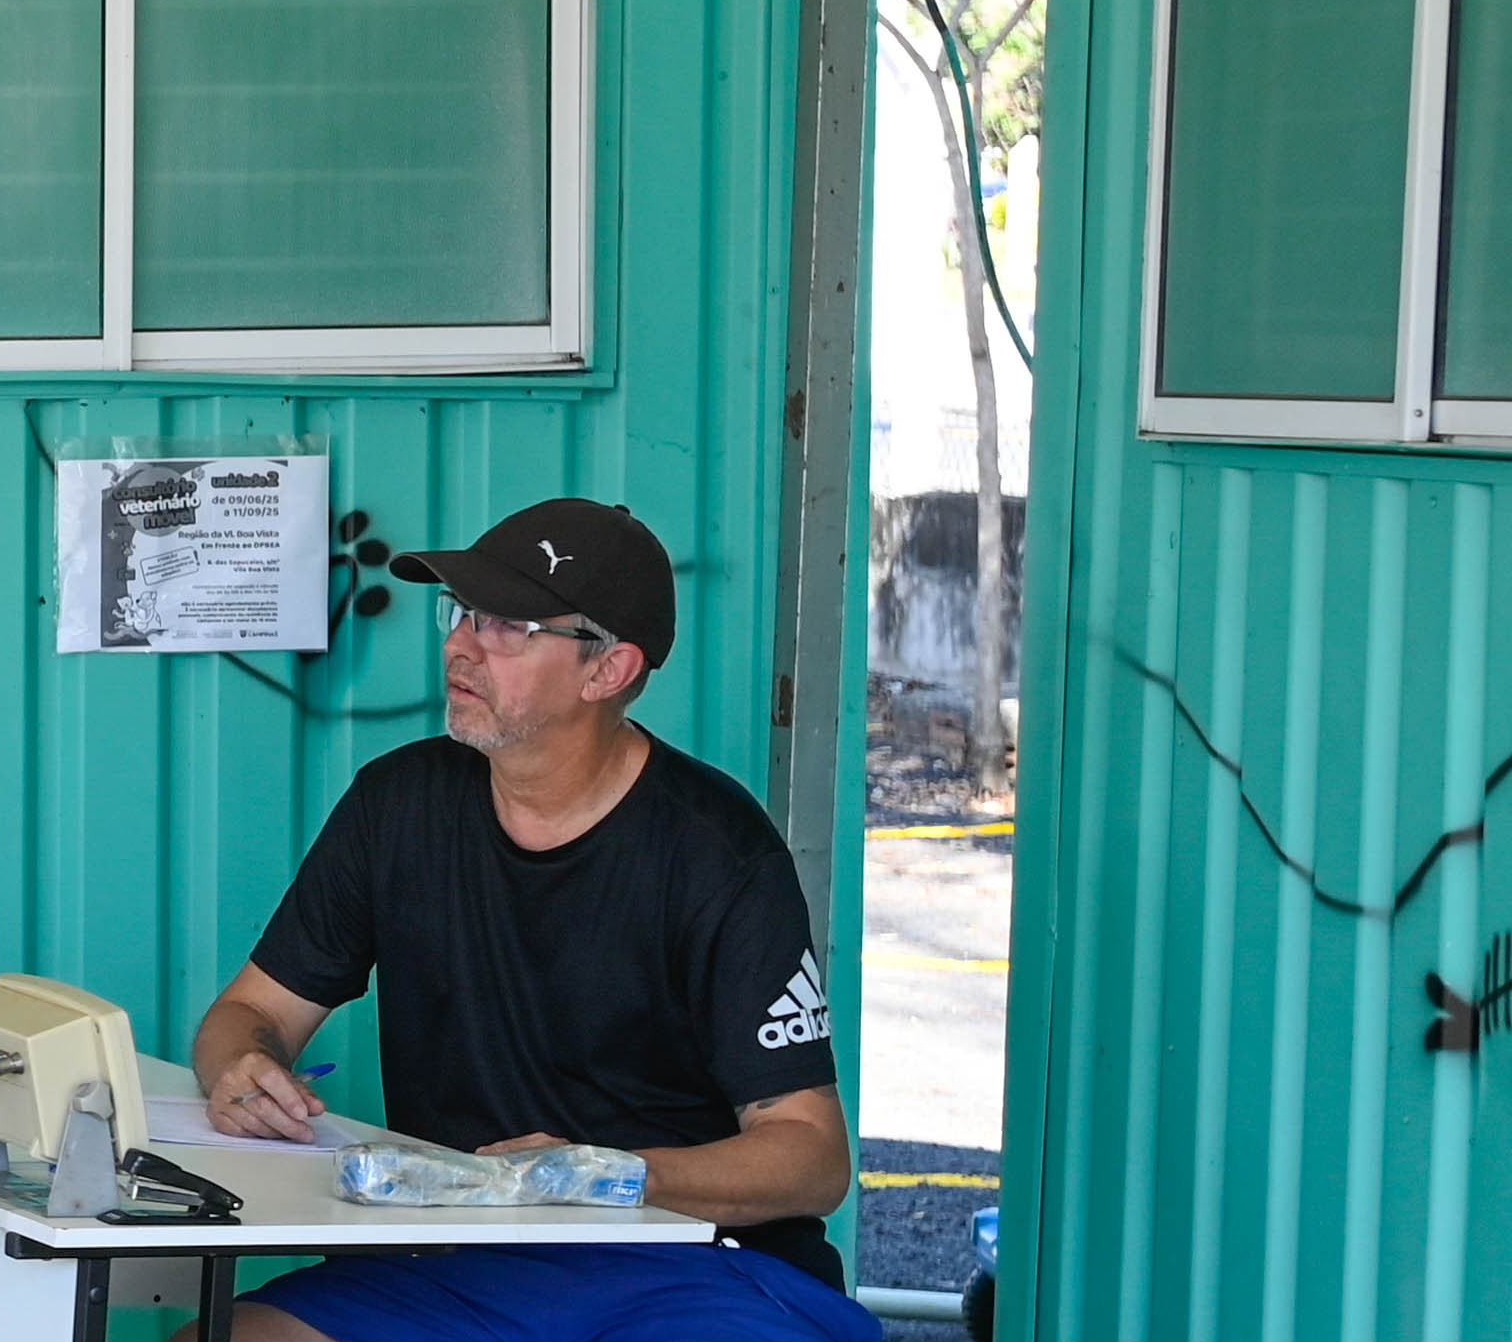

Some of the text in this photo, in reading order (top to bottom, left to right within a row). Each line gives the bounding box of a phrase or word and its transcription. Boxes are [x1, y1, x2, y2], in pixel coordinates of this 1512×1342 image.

[267, 471, 279, 487] 2
[119, 493, 202, 516] veterinário
[212, 496, 225, 504] de
[256, 530, 279, 538] Vista
